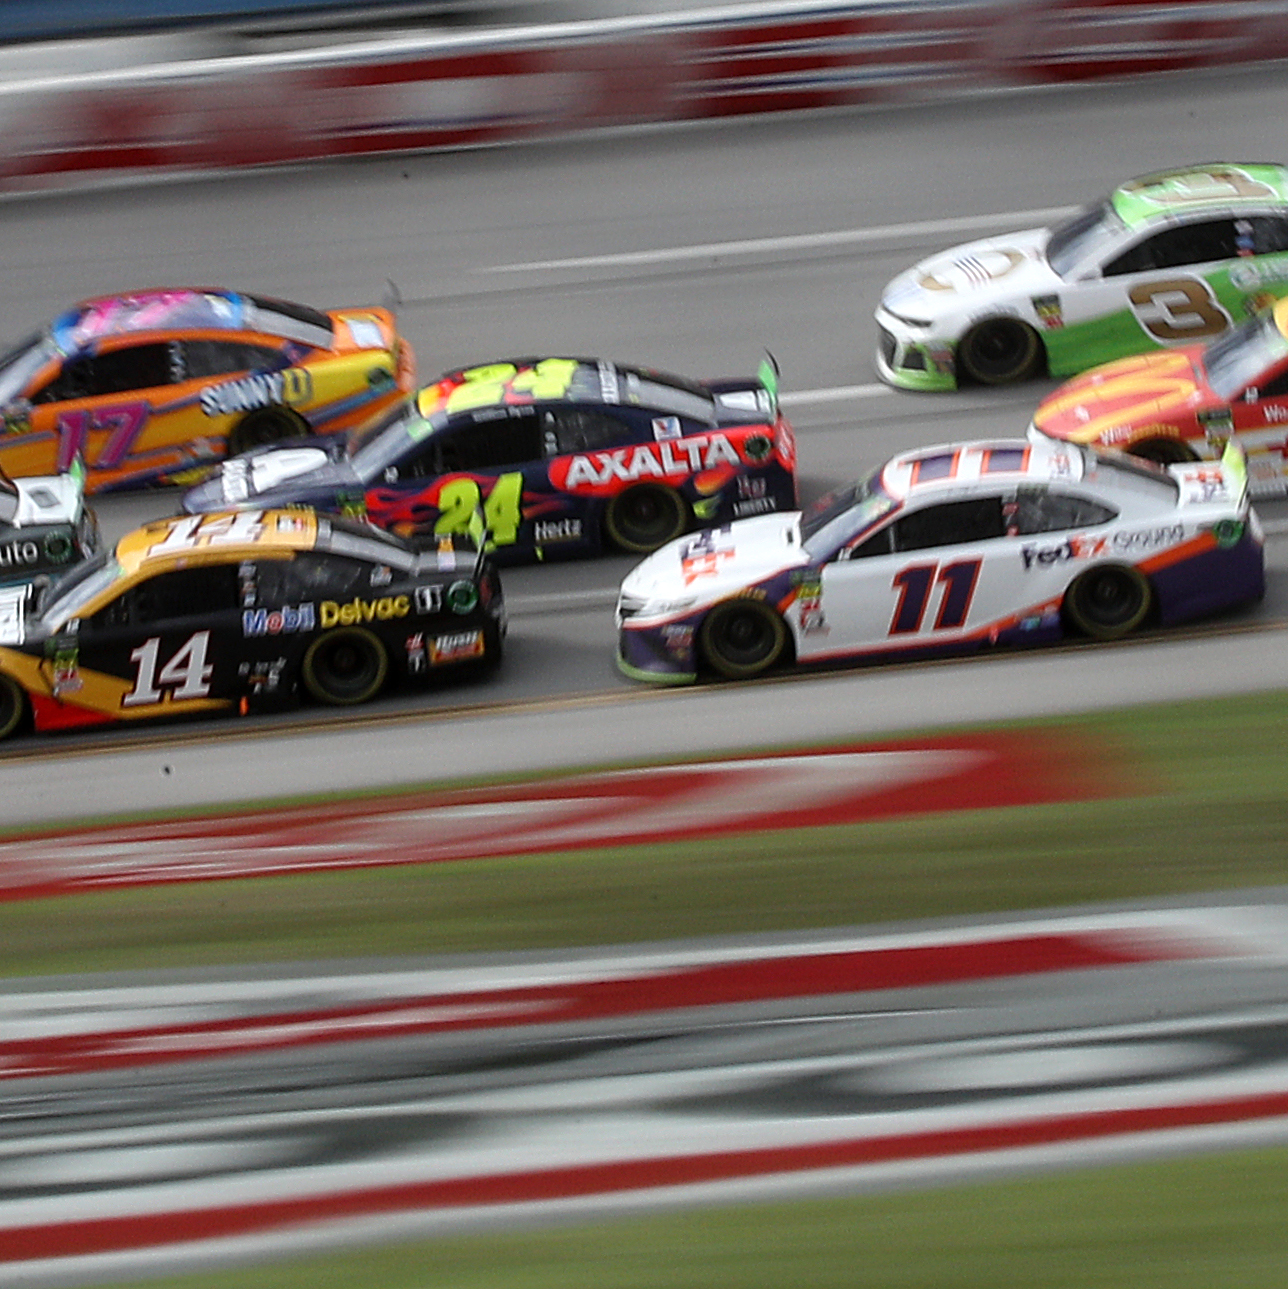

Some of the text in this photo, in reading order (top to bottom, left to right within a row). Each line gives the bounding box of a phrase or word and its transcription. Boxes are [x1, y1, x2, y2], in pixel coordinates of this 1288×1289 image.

[1126, 278, 1234, 347] 3
[446, 358, 579, 414] 24
[57, 400, 150, 471] 17
[565, 433, 741, 490] AXALTA
[148, 510, 267, 558] 14
[434, 472, 523, 554] 24
[243, 600, 315, 639] Mobil
[319, 594, 411, 629] Delvac
[887, 556, 984, 636] 11
[122, 630, 214, 708] 14
